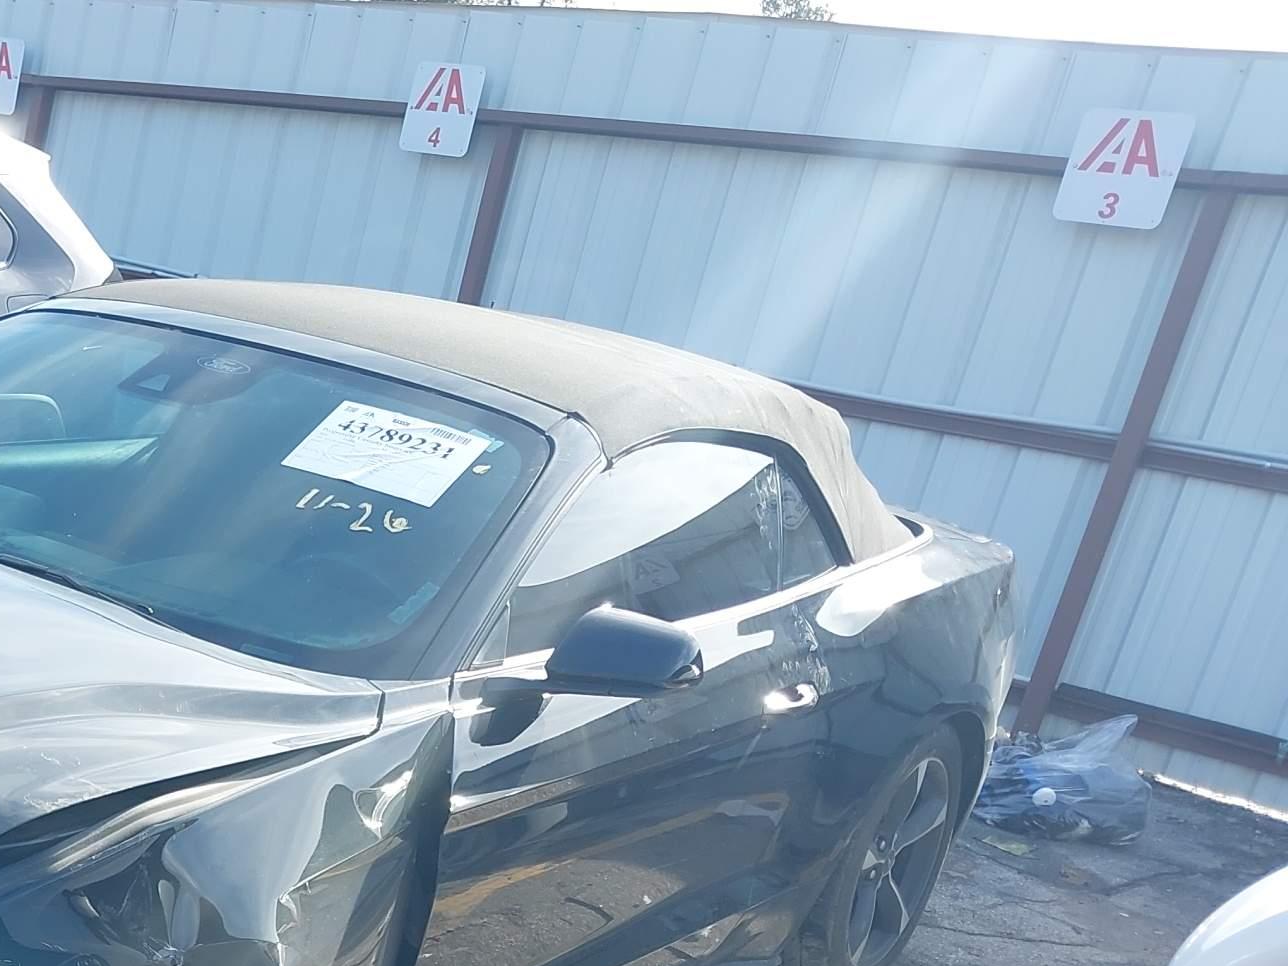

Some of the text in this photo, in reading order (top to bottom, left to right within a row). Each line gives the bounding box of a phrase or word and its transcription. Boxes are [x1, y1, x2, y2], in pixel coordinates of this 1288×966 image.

[427, 127, 441, 148] 4
[1098, 192, 1120, 219] 3
[338, 419, 456, 460] 43789231
